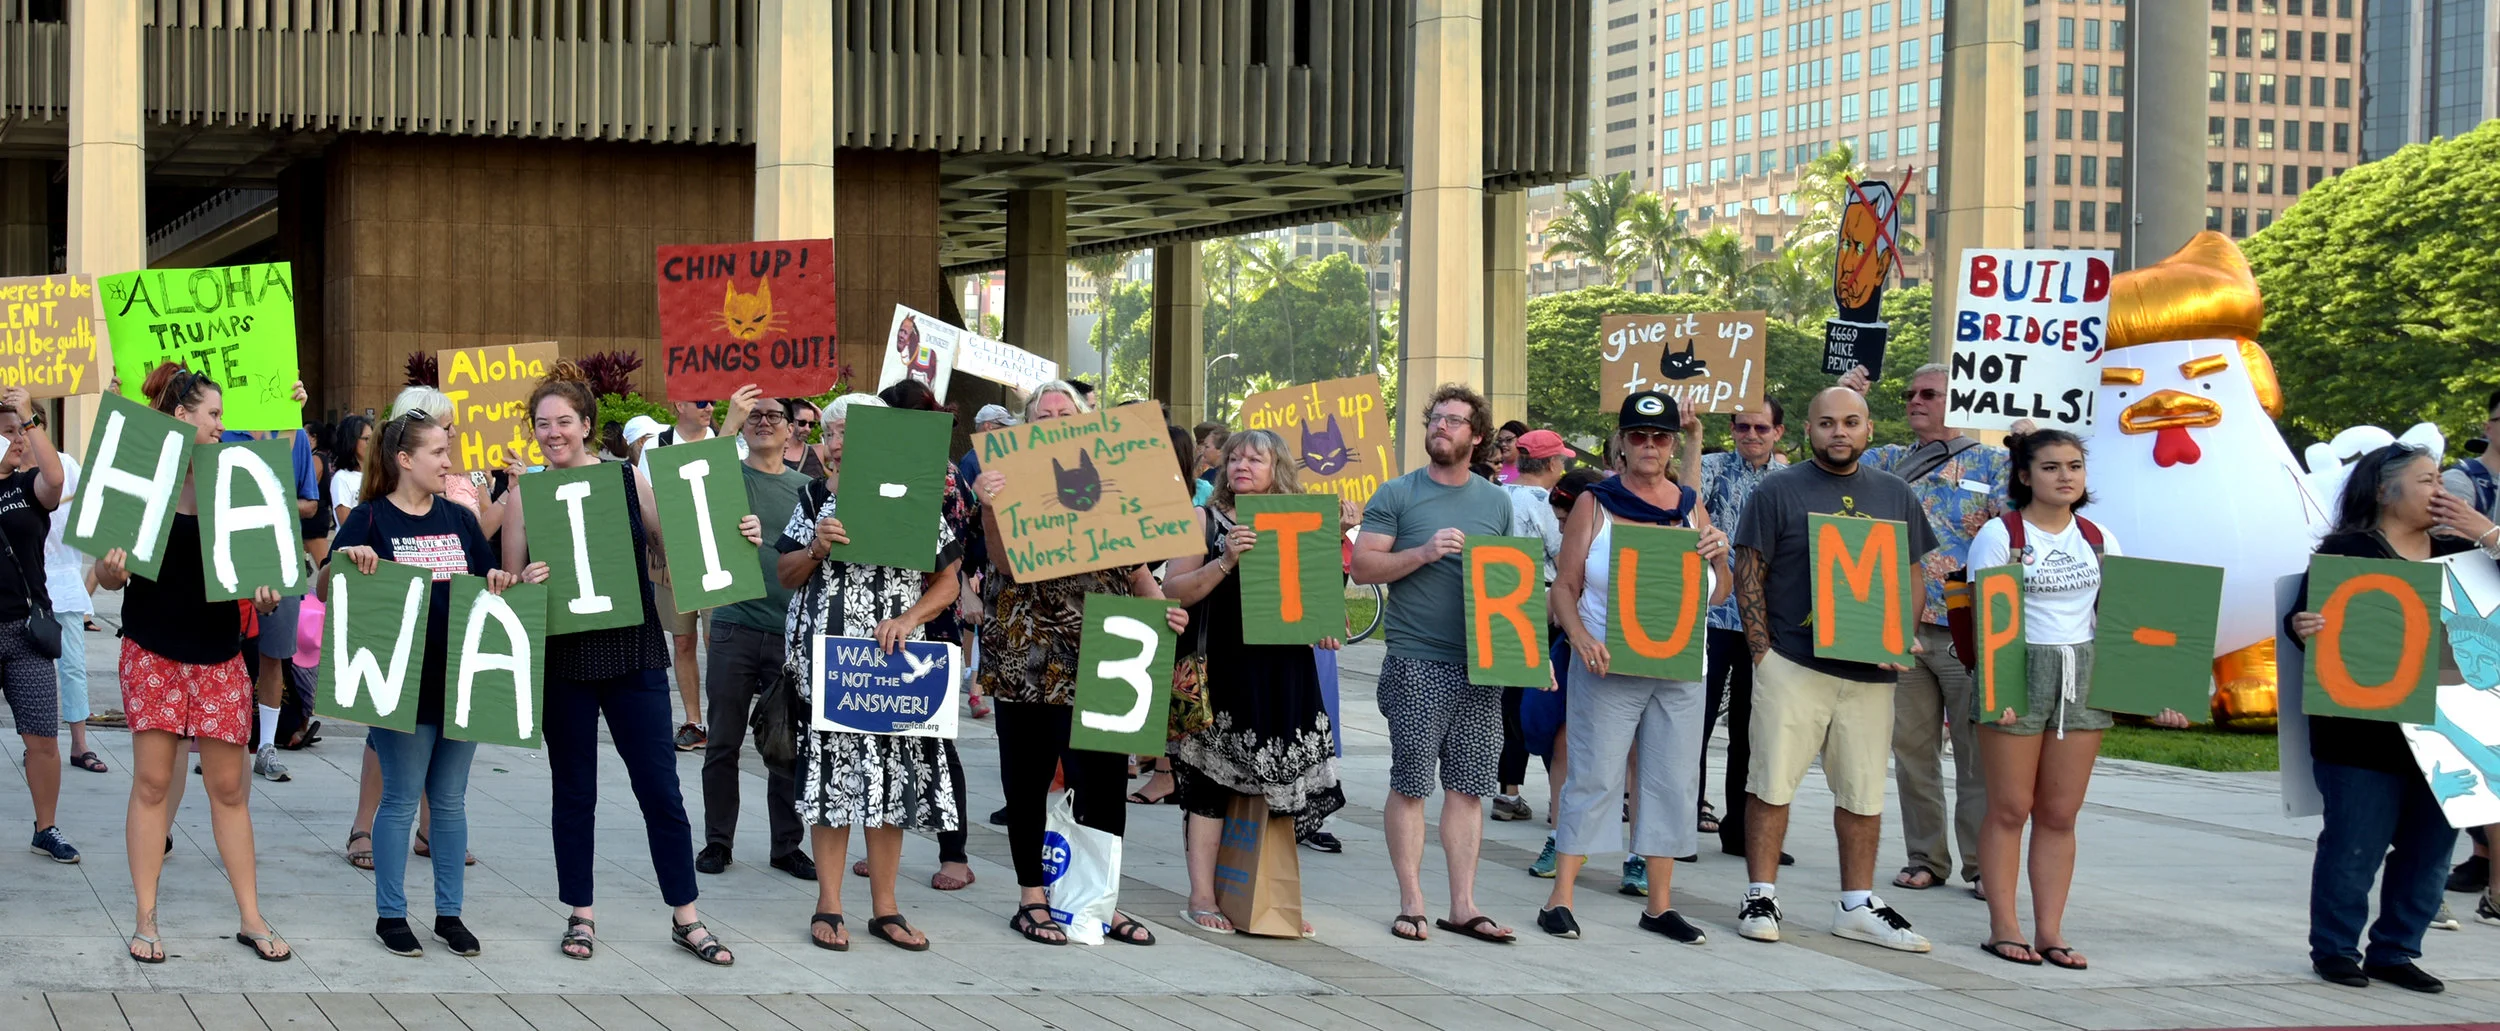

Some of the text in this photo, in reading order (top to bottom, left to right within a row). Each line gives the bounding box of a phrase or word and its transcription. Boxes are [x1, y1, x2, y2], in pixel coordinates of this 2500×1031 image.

[41, 277, 66, 299] to
[70, 275, 91, 298] be
[664, 254, 736, 281] CHIN
[1970, 255, 2110, 303] BUILD
[119, 263, 294, 317] ALOHA
[30, 328, 56, 356] be
[57, 315, 97, 361] guilty
[149, 315, 254, 350] TRUMPS
[1602, 313, 1754, 362] give it up
[1829, 341, 1854, 357] MIKE
[1830, 326, 1858, 342] 46669
[1957, 310, 2103, 363] BRIDGES,
[448, 346, 546, 385] Aloha
[668, 336, 835, 376] FANGS OUT!
[1827, 356, 1859, 372] PENCE
[1952, 351, 2028, 384] NOT
[443, 390, 534, 432] Trum
[1303, 382, 1326, 421] it
[1337, 393, 1374, 440] up
[1950, 388, 2093, 426] WALLS!
[461, 424, 544, 471] Hate
[984, 410, 1121, 463] All Animals
[1000, 496, 1142, 538] Trump is
[418, 540, 437, 548] LOVE
[1007, 539, 1077, 574] Worst
[1138, 515, 1192, 541] Ever
[836, 645, 888, 667] WAR
[1080, 616, 1159, 734] 3
[828, 670, 900, 688] IS NOT THE
[837, 691, 929, 715] ANSWER!
